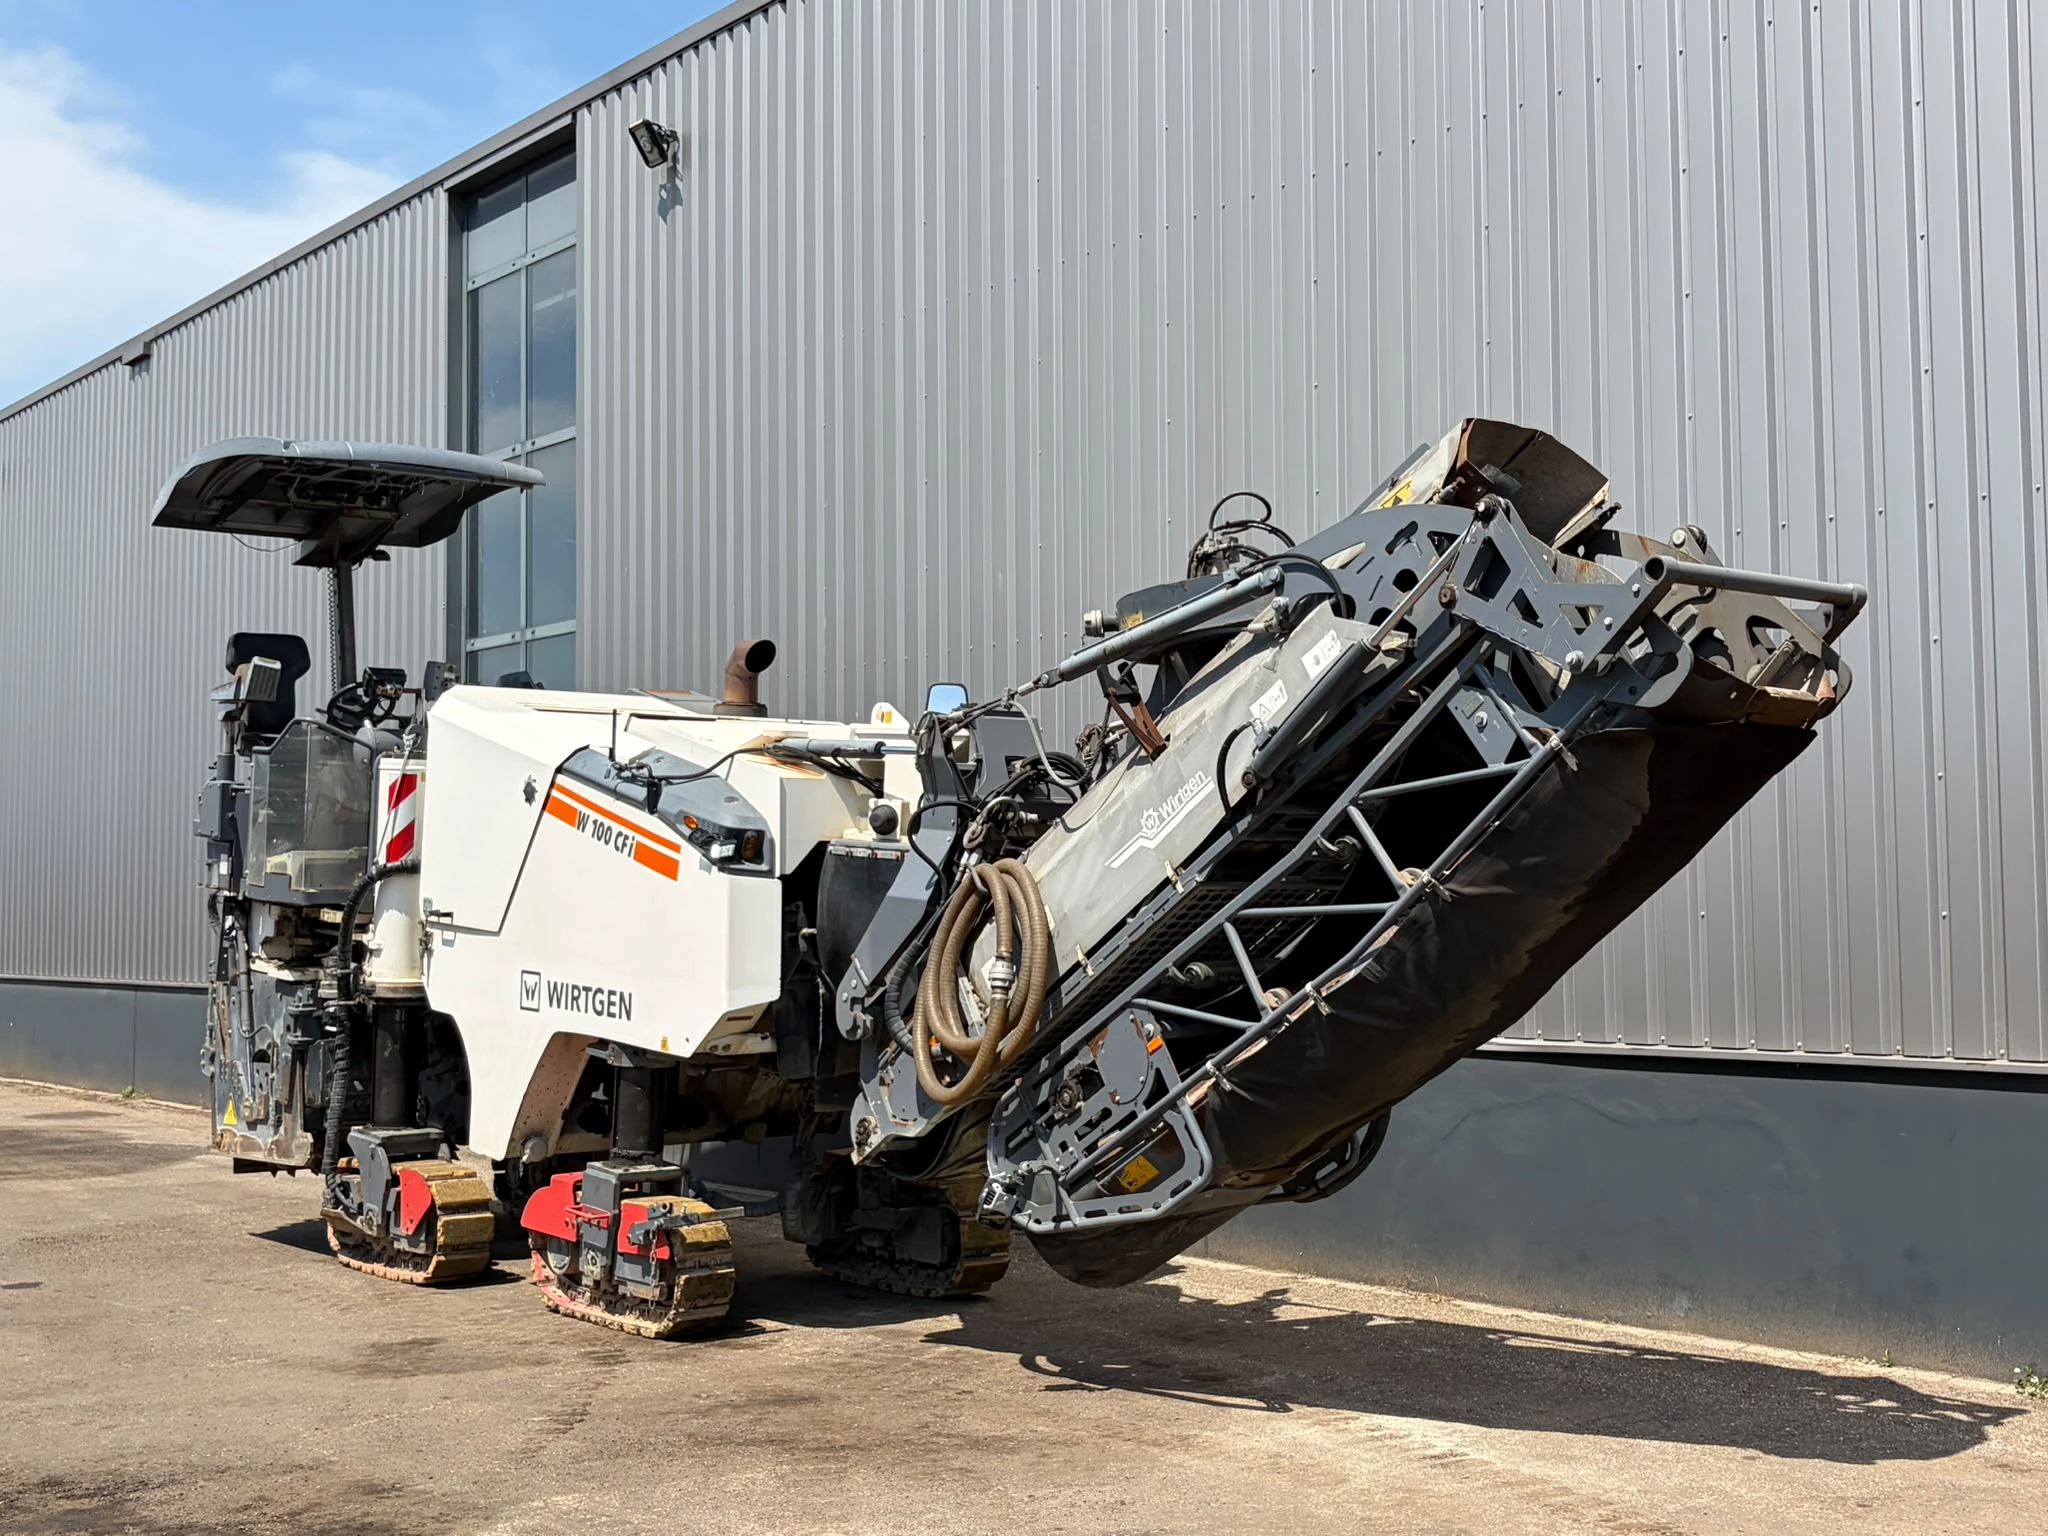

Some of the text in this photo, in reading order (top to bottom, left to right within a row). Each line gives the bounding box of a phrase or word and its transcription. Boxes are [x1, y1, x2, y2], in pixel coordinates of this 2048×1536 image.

[1159, 770, 1206, 821] Wirtgen
[577, 811, 590, 833] W
[592, 819, 612, 845] 100
[547, 979, 632, 1021] WIRTGEN
